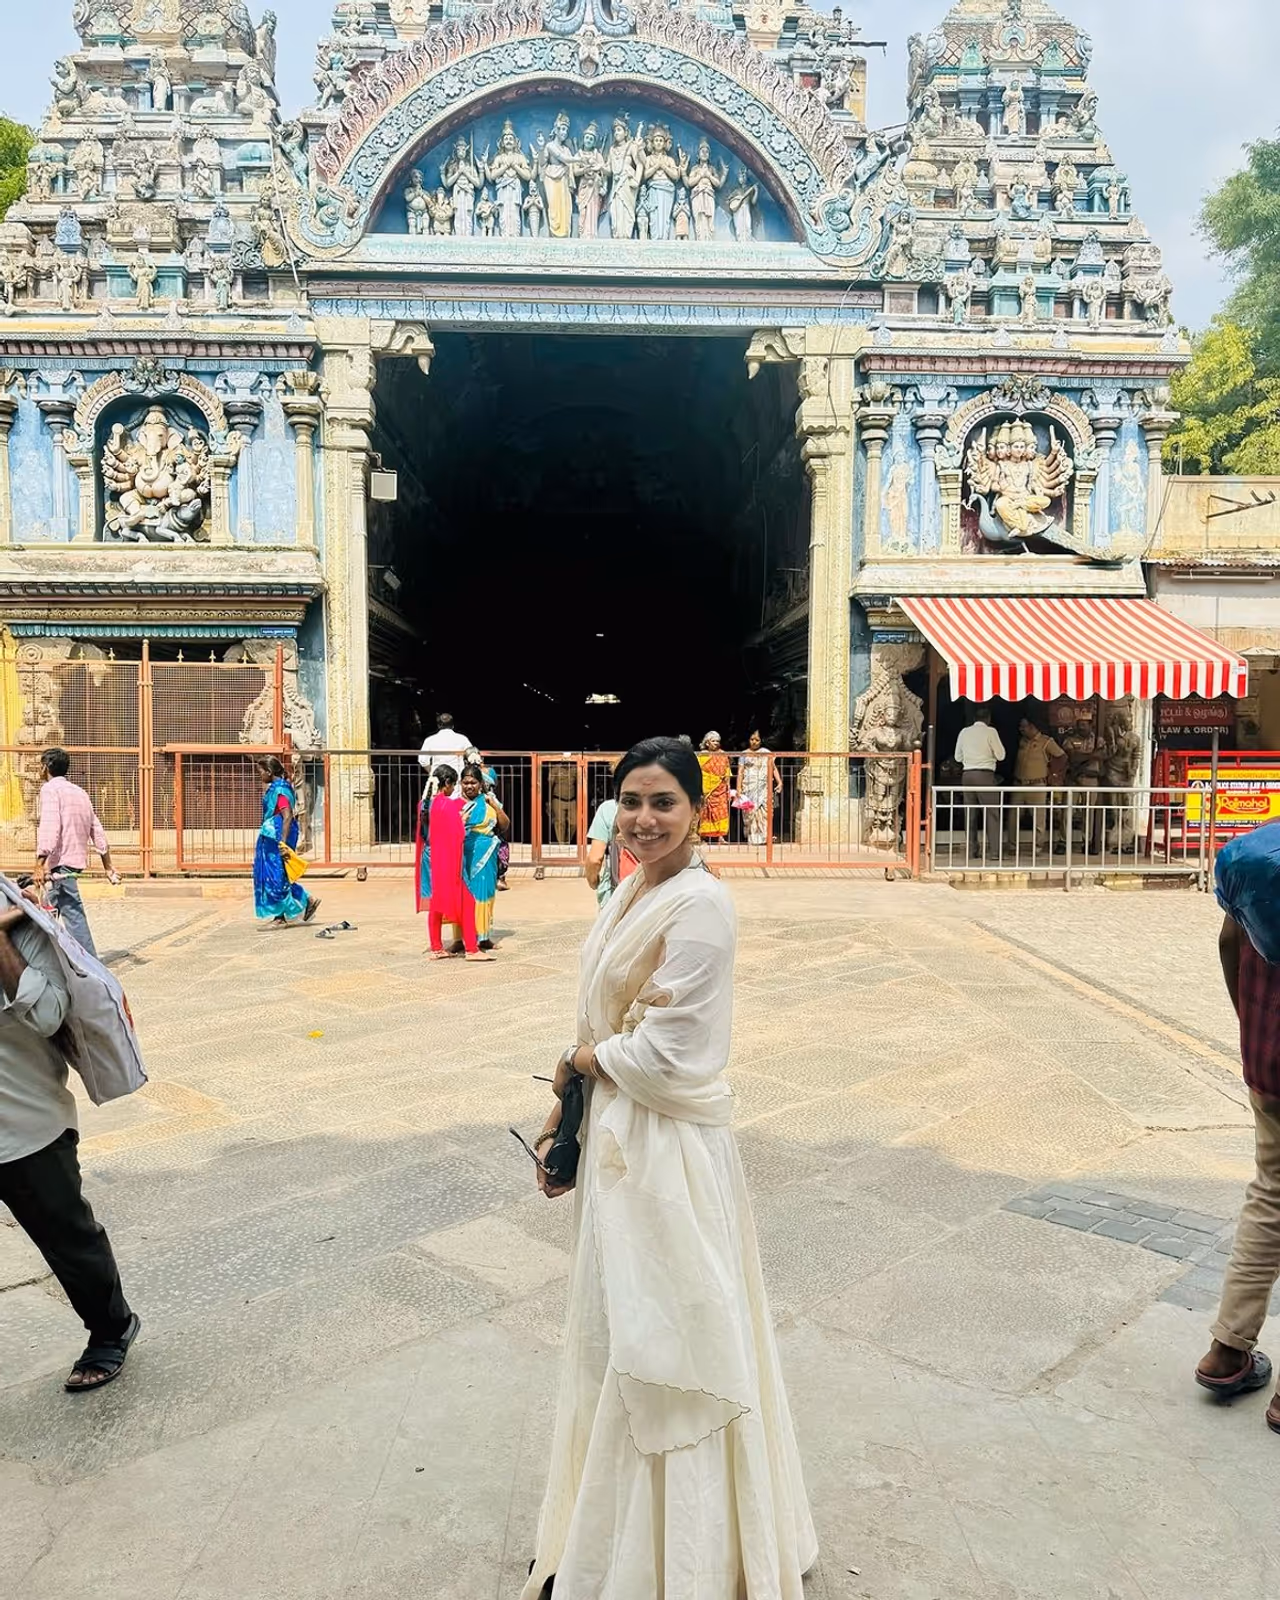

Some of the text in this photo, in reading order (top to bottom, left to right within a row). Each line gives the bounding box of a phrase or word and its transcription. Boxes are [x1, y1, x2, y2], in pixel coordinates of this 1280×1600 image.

[1183, 726, 1191, 734] &
[1193, 726, 1229, 735] ORDR)
[1221, 796, 1268, 809] Rajmahal
